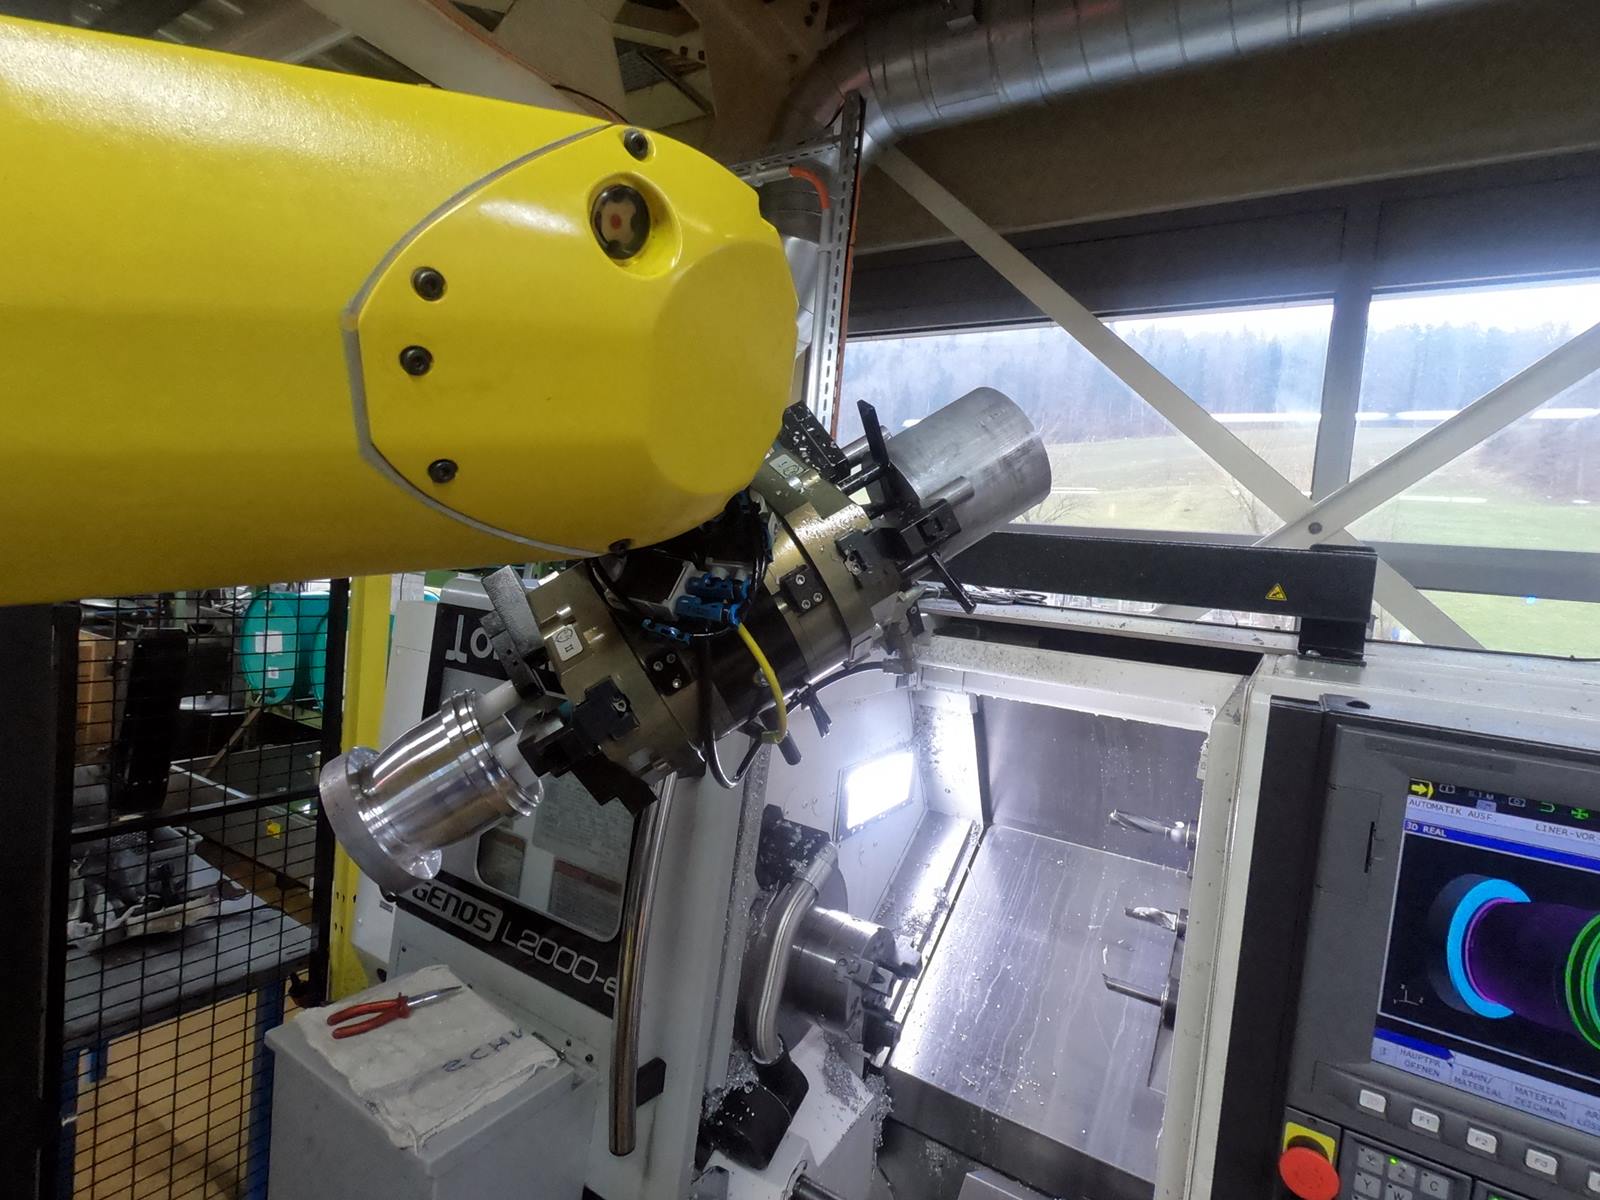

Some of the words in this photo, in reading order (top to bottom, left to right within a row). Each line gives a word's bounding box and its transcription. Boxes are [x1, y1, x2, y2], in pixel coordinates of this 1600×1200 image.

[1408, 799, 1462, 816] AUTOMATIK
[1406, 822, 1419, 832] 3D
[1422, 825, 1447, 838] REAL
[411, 882, 497, 934] GENOS
[1454, 1077, 1504, 1099] MATERIAL
[1514, 1086, 1567, 1110] MATERIAL
[1474, 1136, 1488, 1147] F2
